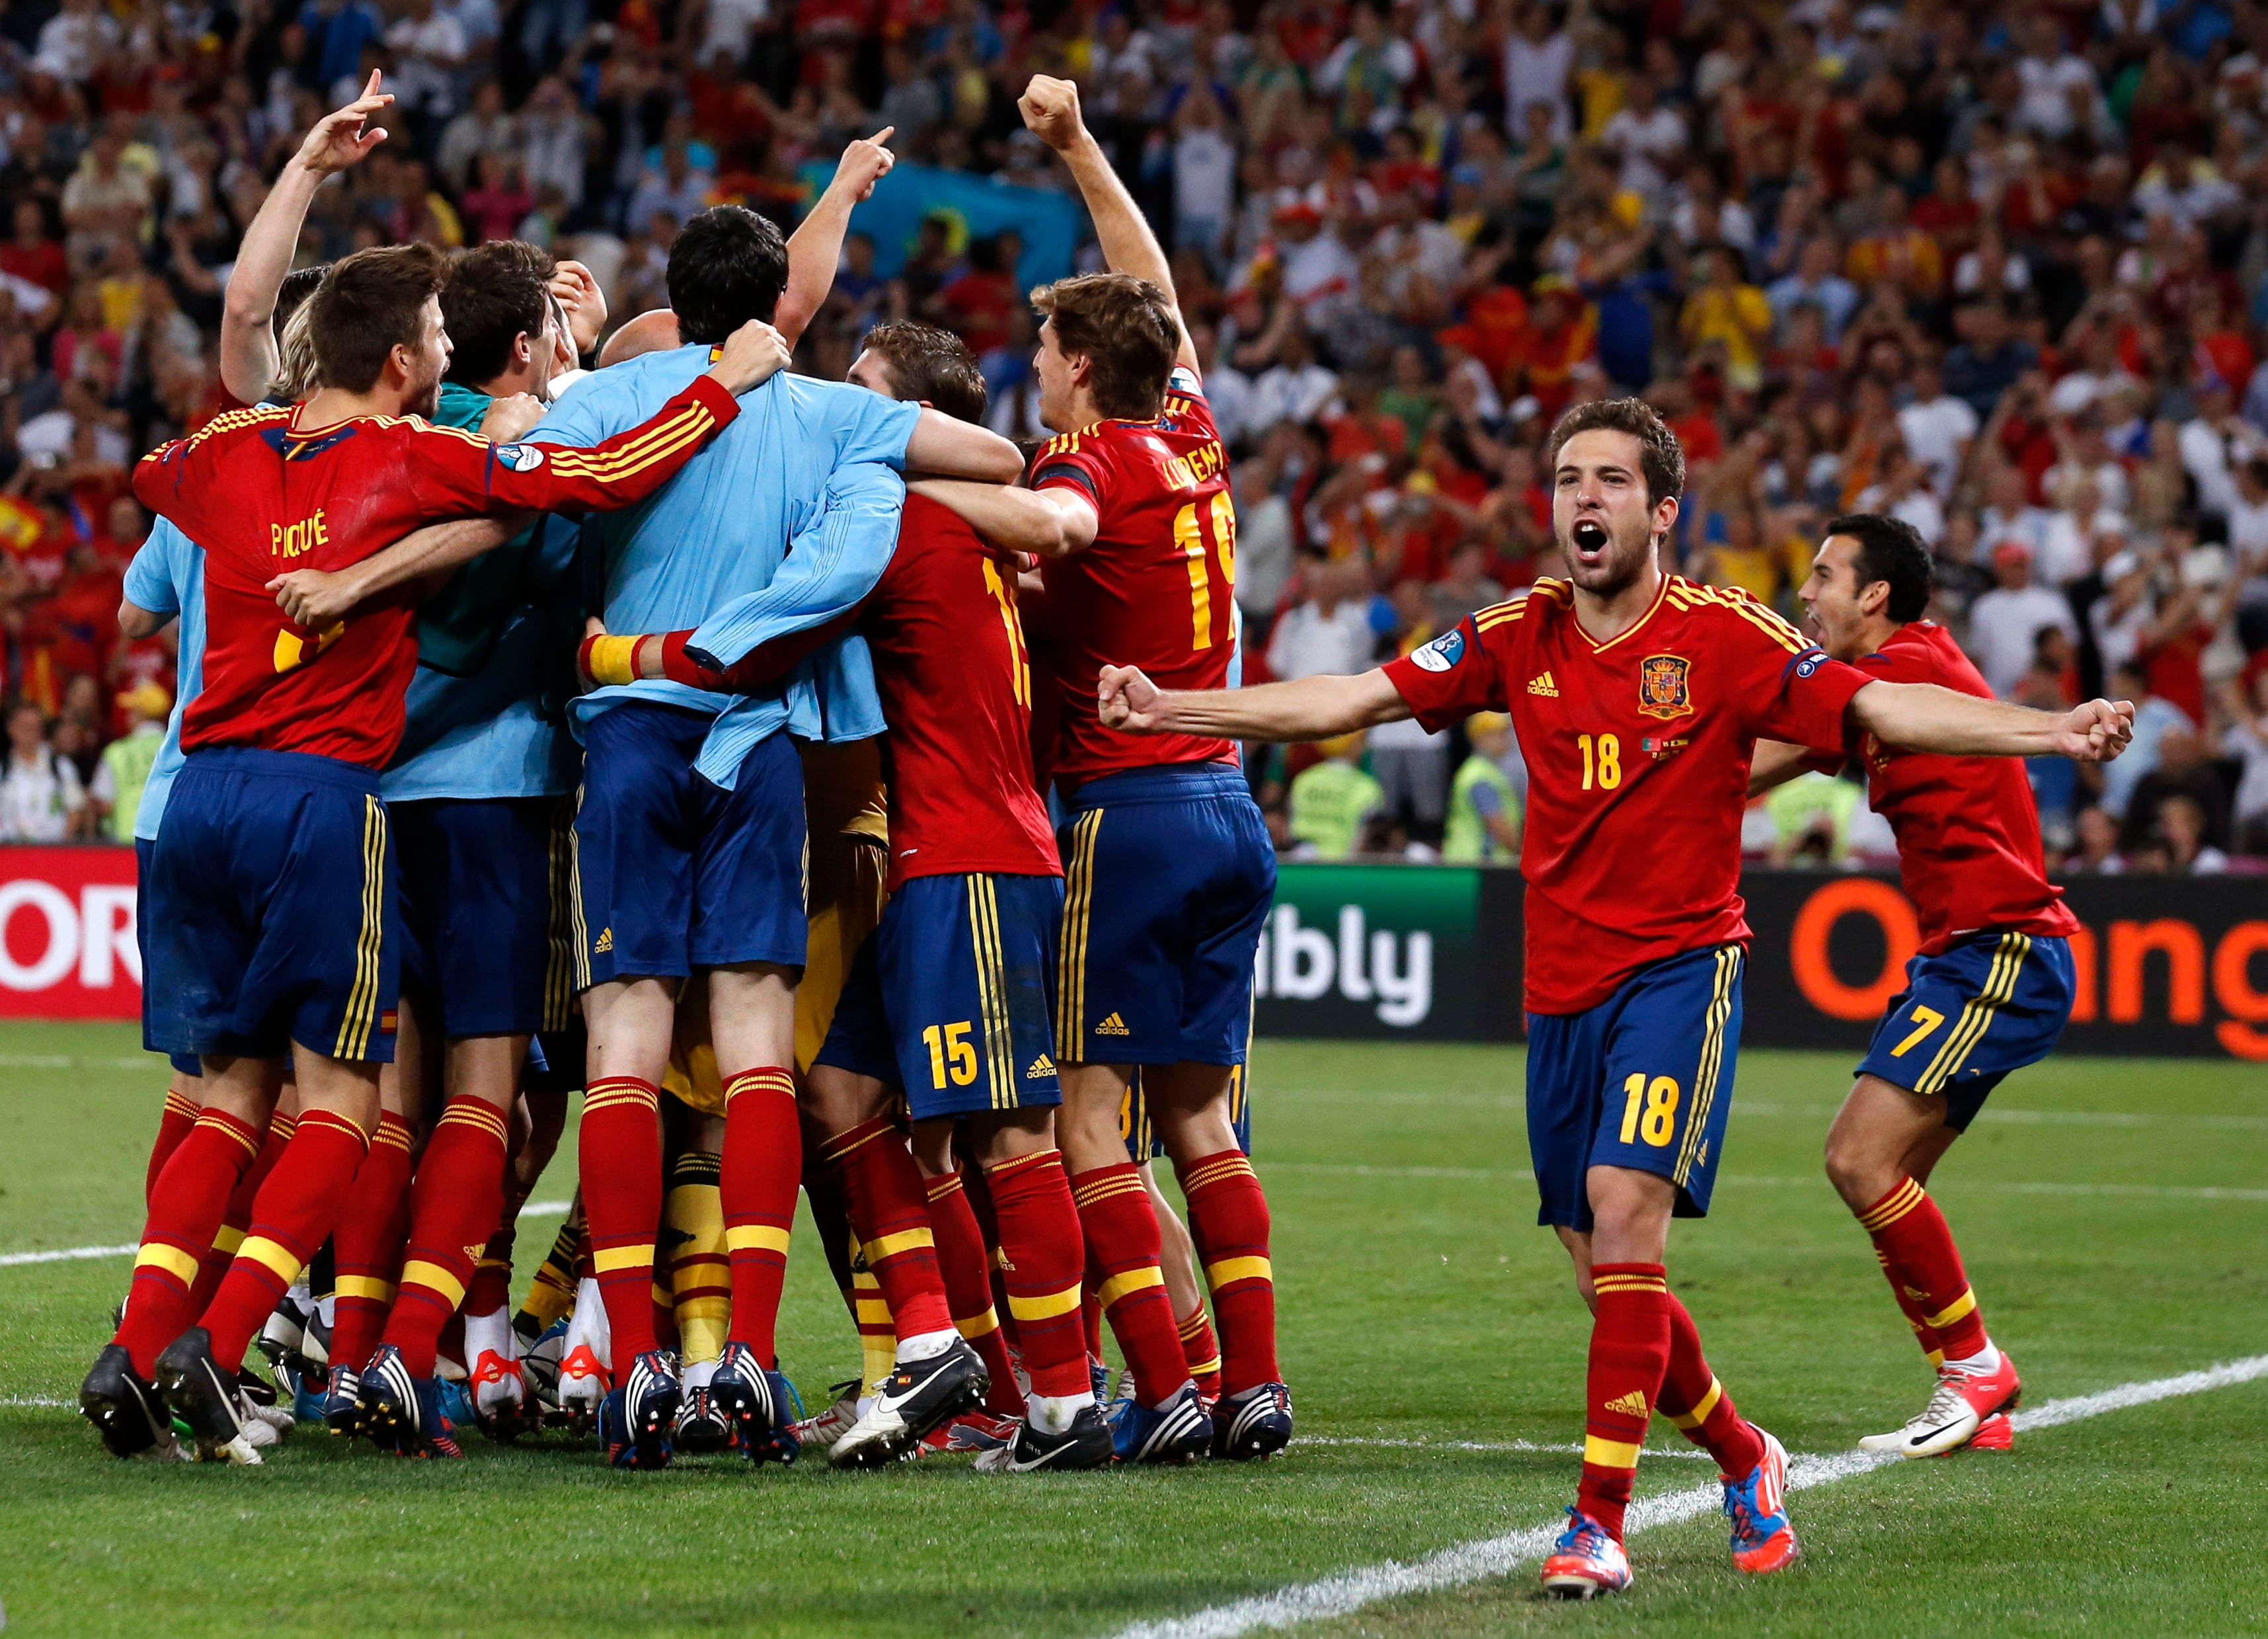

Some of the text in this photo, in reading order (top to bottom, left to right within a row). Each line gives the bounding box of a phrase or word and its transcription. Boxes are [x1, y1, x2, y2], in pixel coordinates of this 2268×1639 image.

[271, 508, 329, 558] PIQUÉ
[1578, 733, 1622, 790] 18
[1791, 878, 2268, 1061] Ong
[923, 1021, 978, 1090] 15
[1095, 1026, 1130, 1035] adidas
[1891, 1005, 1945, 1057] 7
[1619, 1072, 1680, 1146] 18
